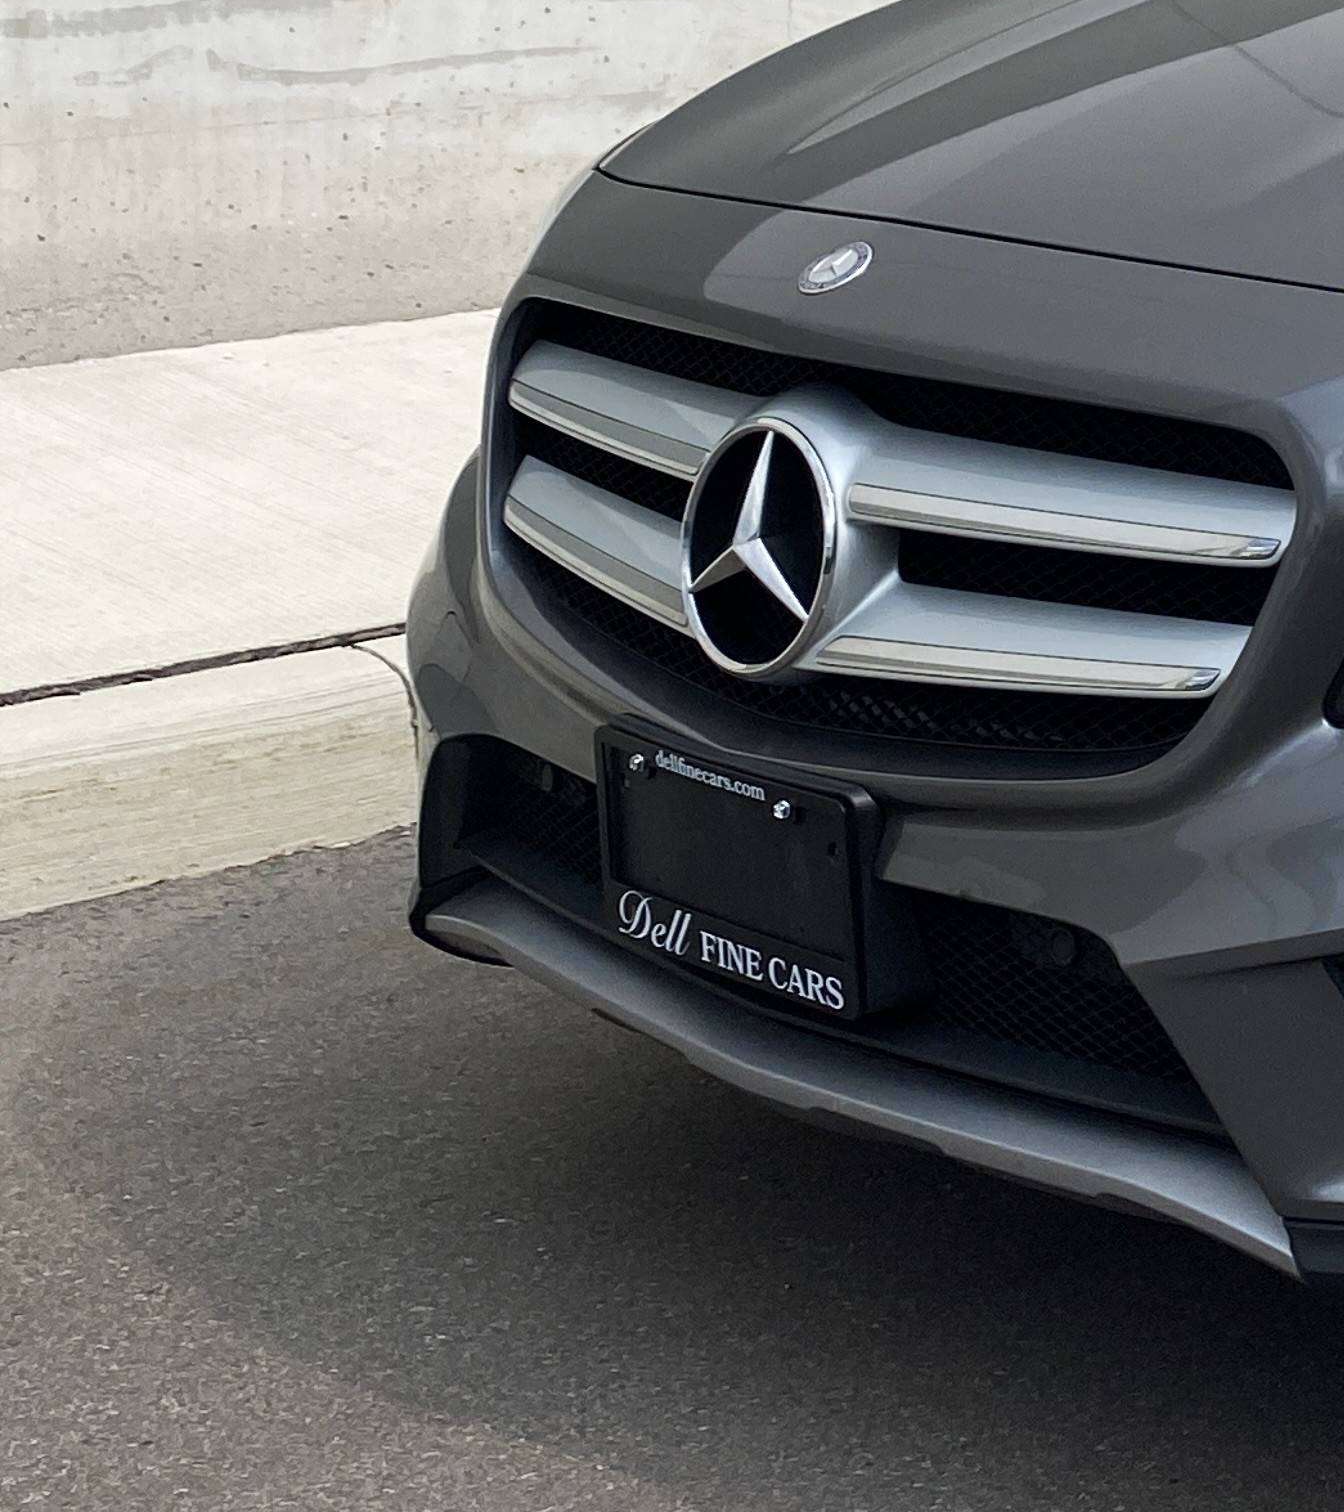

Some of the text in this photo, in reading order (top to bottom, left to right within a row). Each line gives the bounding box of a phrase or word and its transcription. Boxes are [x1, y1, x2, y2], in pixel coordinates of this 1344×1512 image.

[654, 750, 765, 802] dellfinecars.com
[618, 890, 845, 1010] Dell FINE CARS
